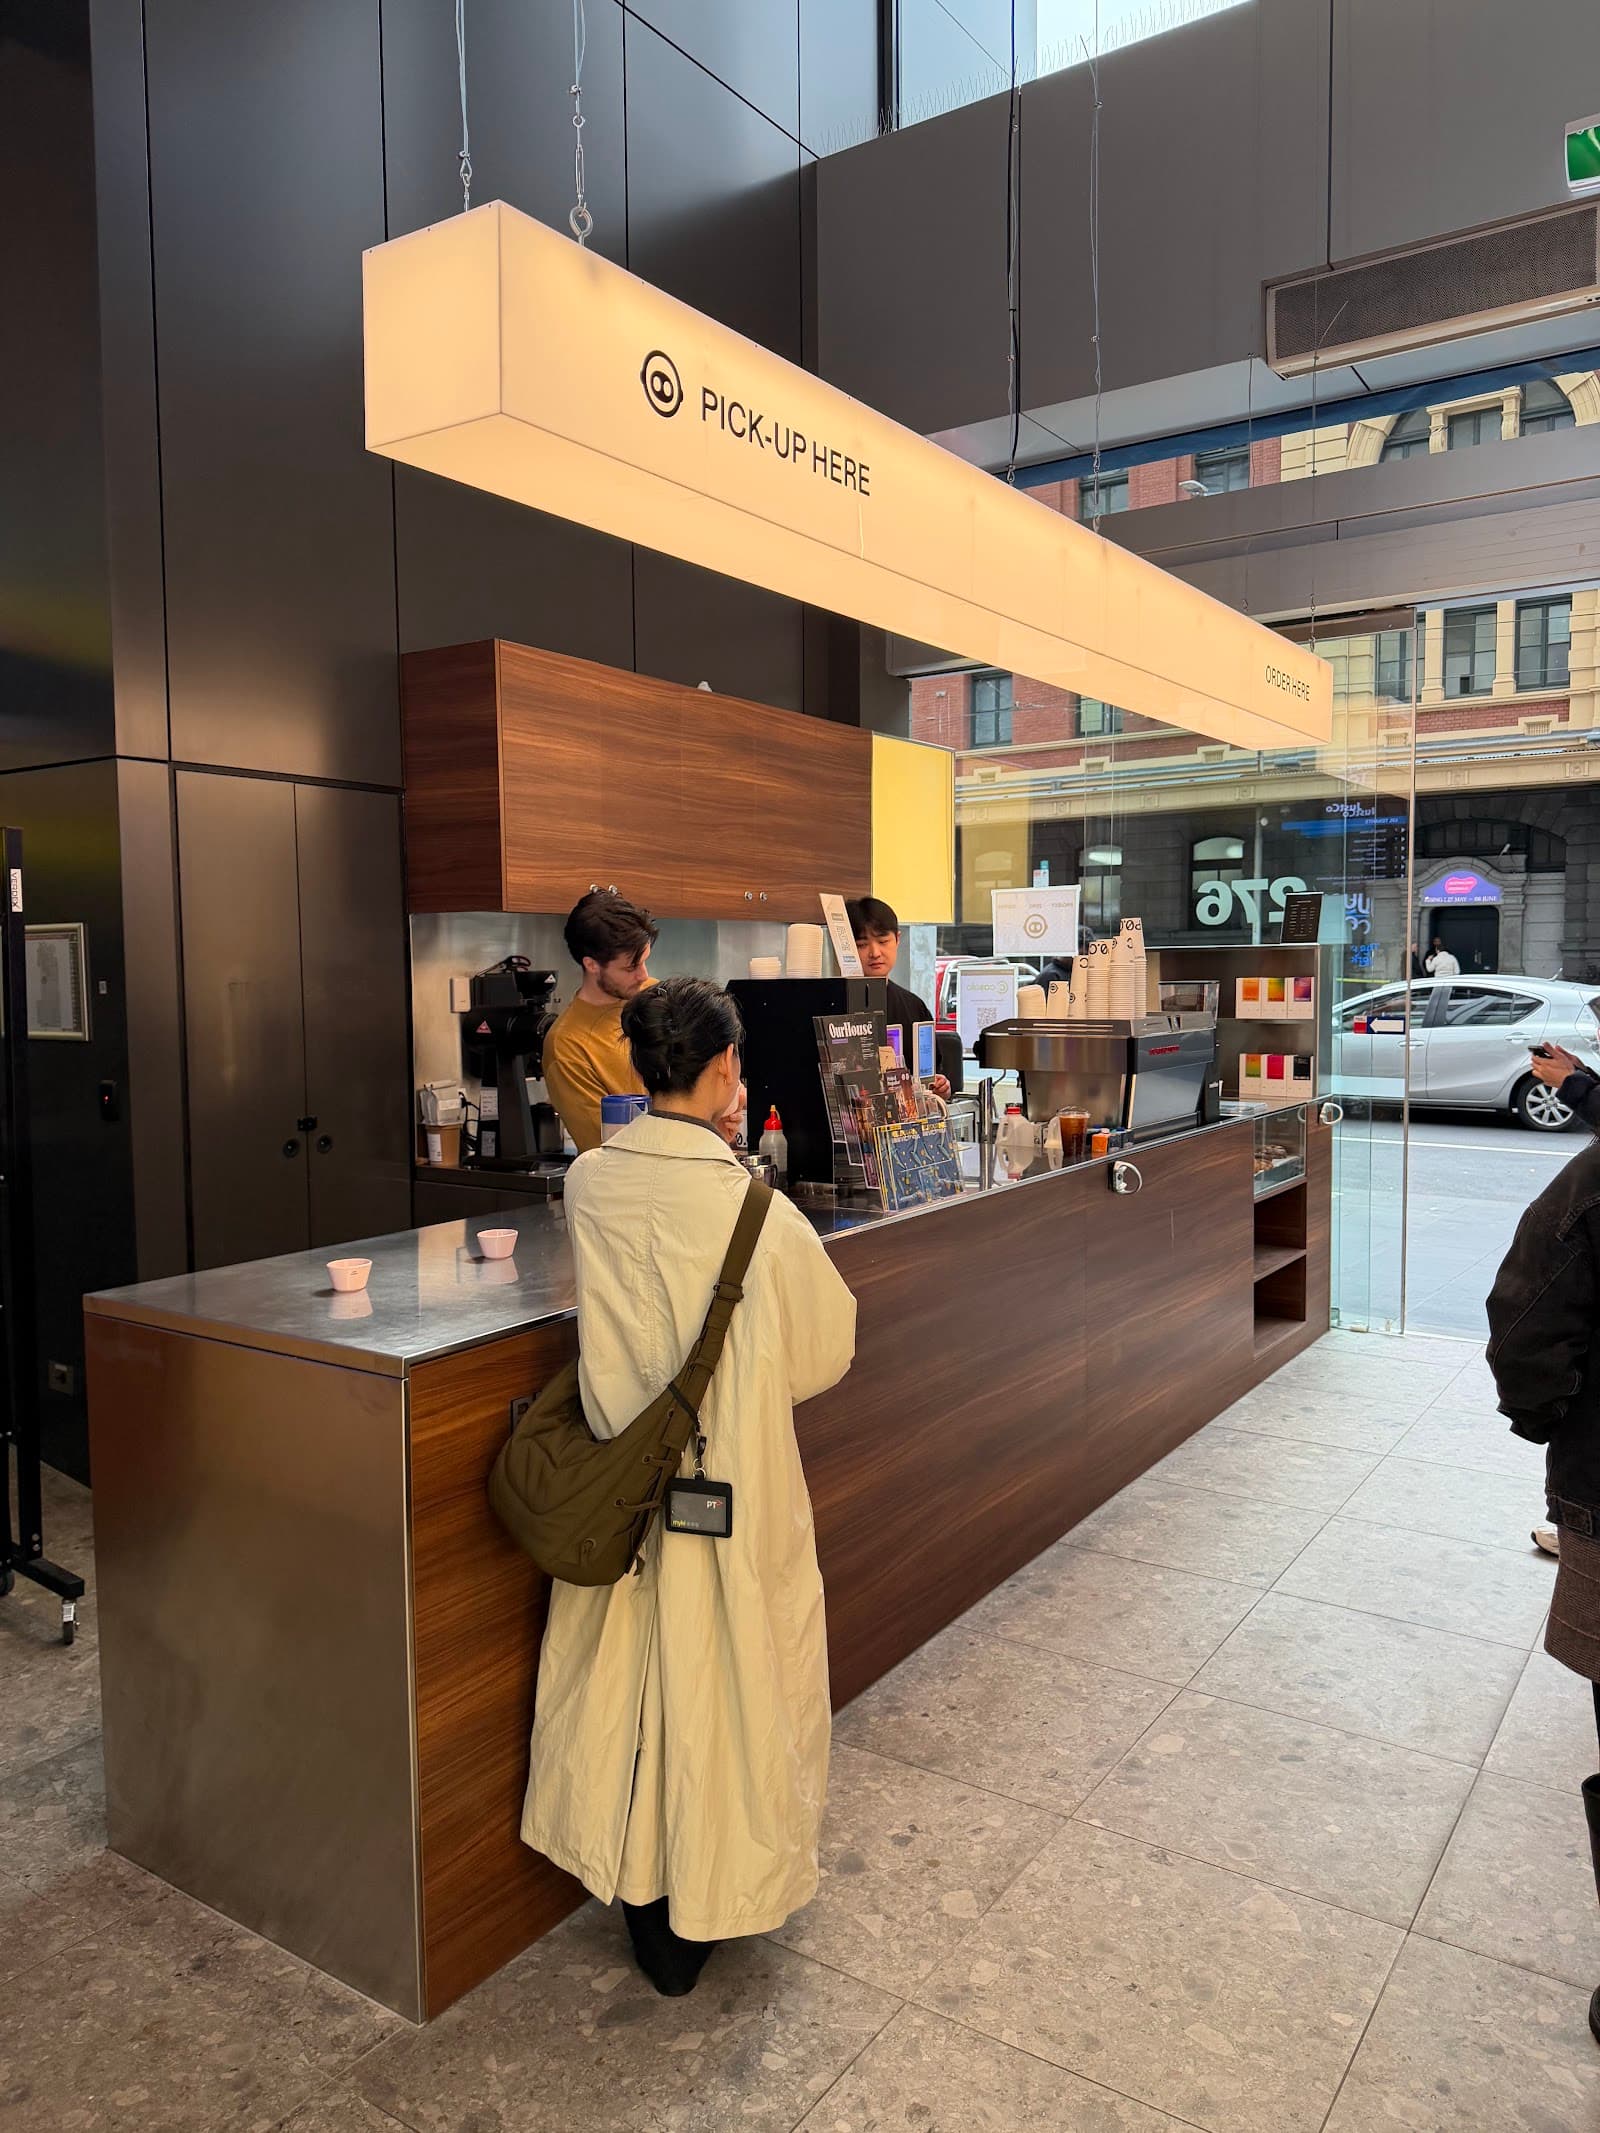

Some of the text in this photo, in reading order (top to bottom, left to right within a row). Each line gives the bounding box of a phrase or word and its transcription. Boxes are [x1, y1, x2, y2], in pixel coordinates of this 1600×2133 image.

[702, 386, 871, 496] PICK-UP HERE
[1265, 665, 1310, 701] ORDER HERE
[828, 1021, 873, 1039] OurHouse
